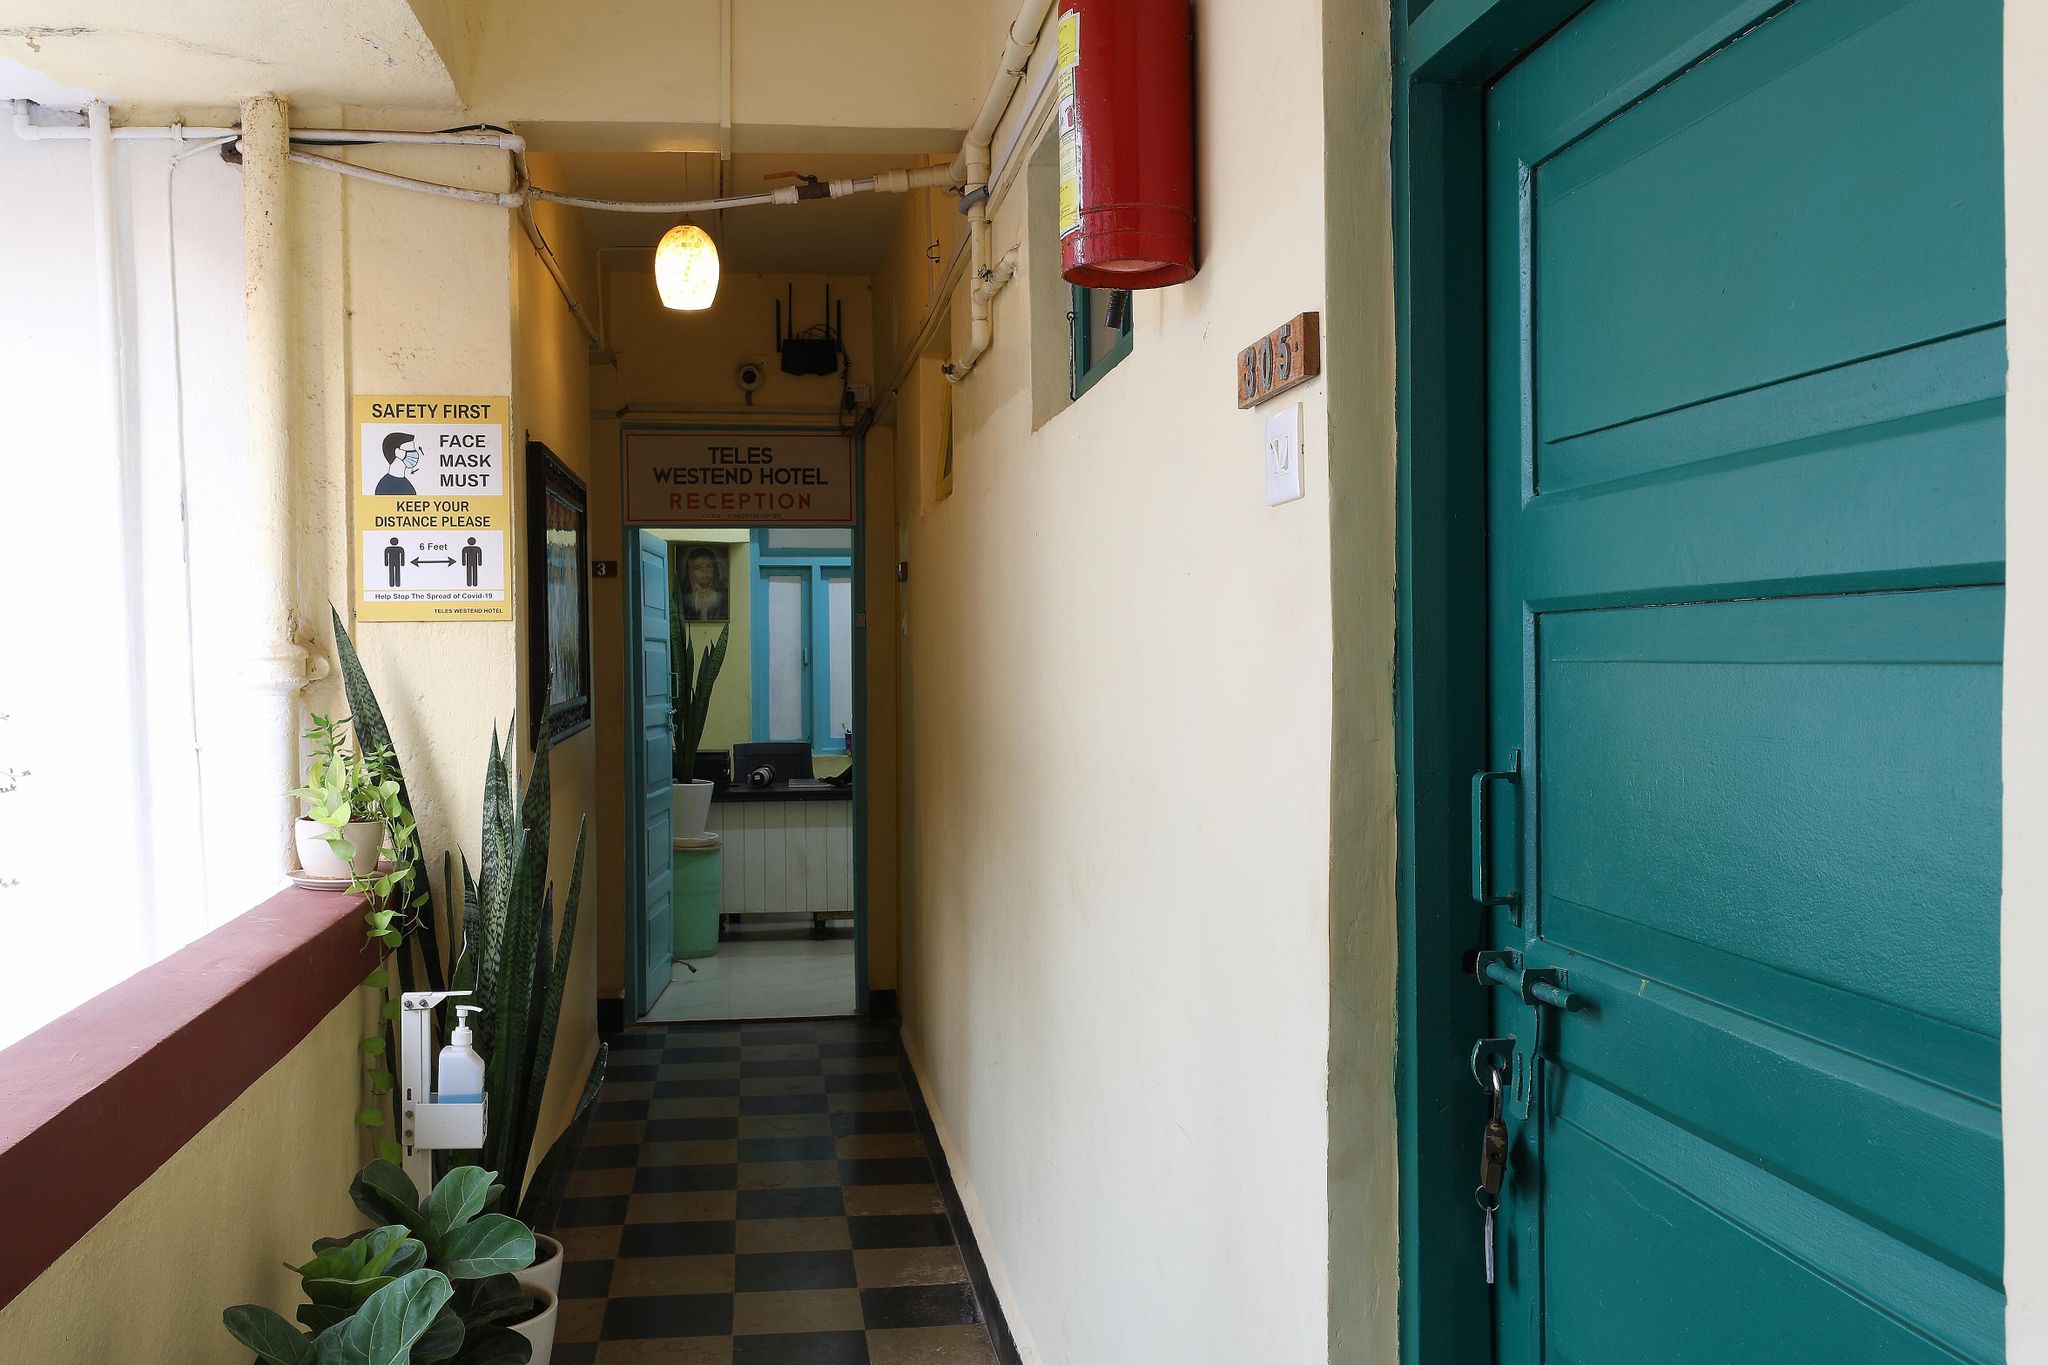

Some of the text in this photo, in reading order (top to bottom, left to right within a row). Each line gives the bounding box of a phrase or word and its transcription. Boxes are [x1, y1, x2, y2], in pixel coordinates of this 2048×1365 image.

[372, 403, 490, 418] SAFETY FIRST
[440, 435, 486, 447] FACE
[440, 454, 492, 467] MASK
[708, 447, 773, 464] TELES
[440, 474, 490, 487] MUST
[653, 467, 828, 485] WESTEND HOTEL
[396, 501, 469, 512] KEEP YOUR
[669, 493, 811, 509] RECEPTION
[375, 516, 491, 527] DISTANCE PLEASE
[419, 543, 448, 551] 6 Feet
[597, 562, 606, 576] 3
